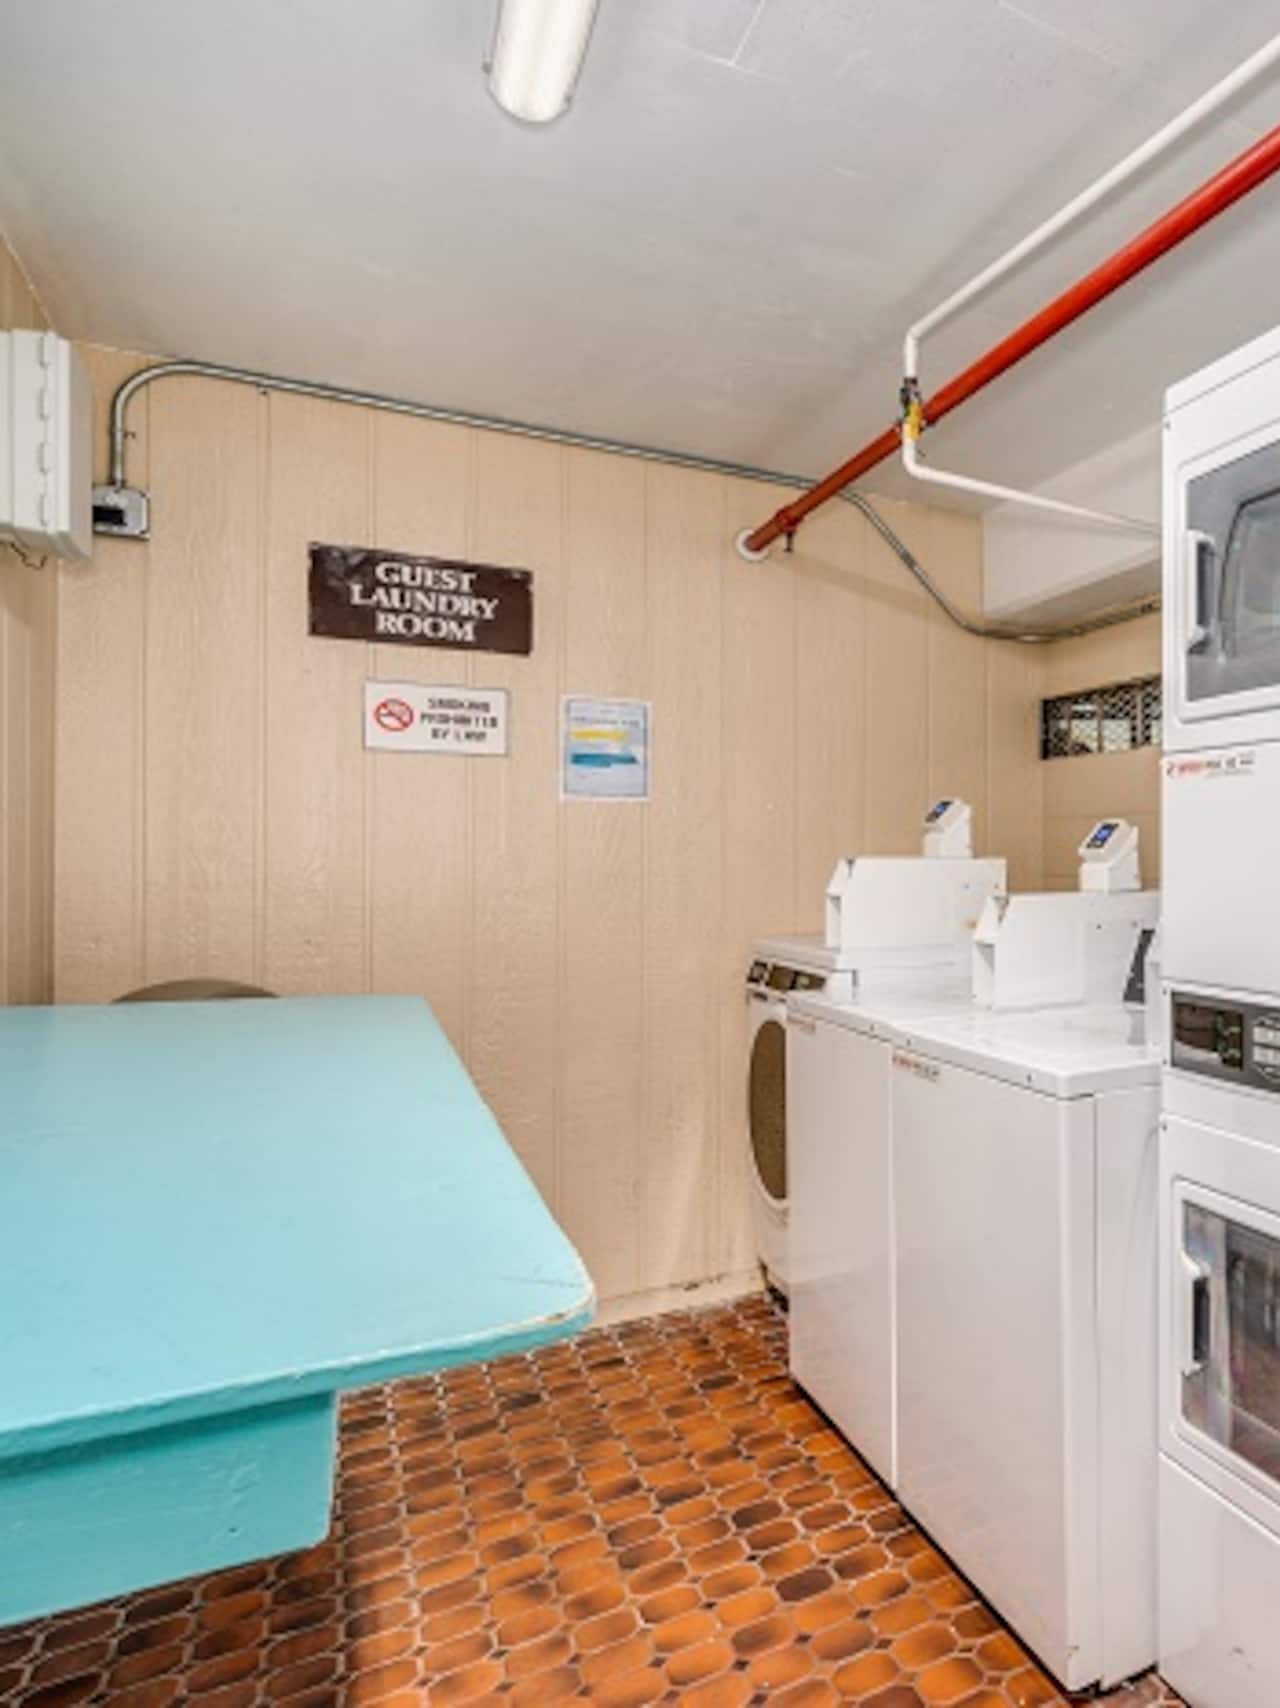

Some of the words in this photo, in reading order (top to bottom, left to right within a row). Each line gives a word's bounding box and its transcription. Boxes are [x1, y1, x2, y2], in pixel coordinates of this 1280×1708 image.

[375, 561, 477, 593] GUEST
[350, 583, 499, 620] LAUNDRY
[375, 610, 477, 642] ROOM
